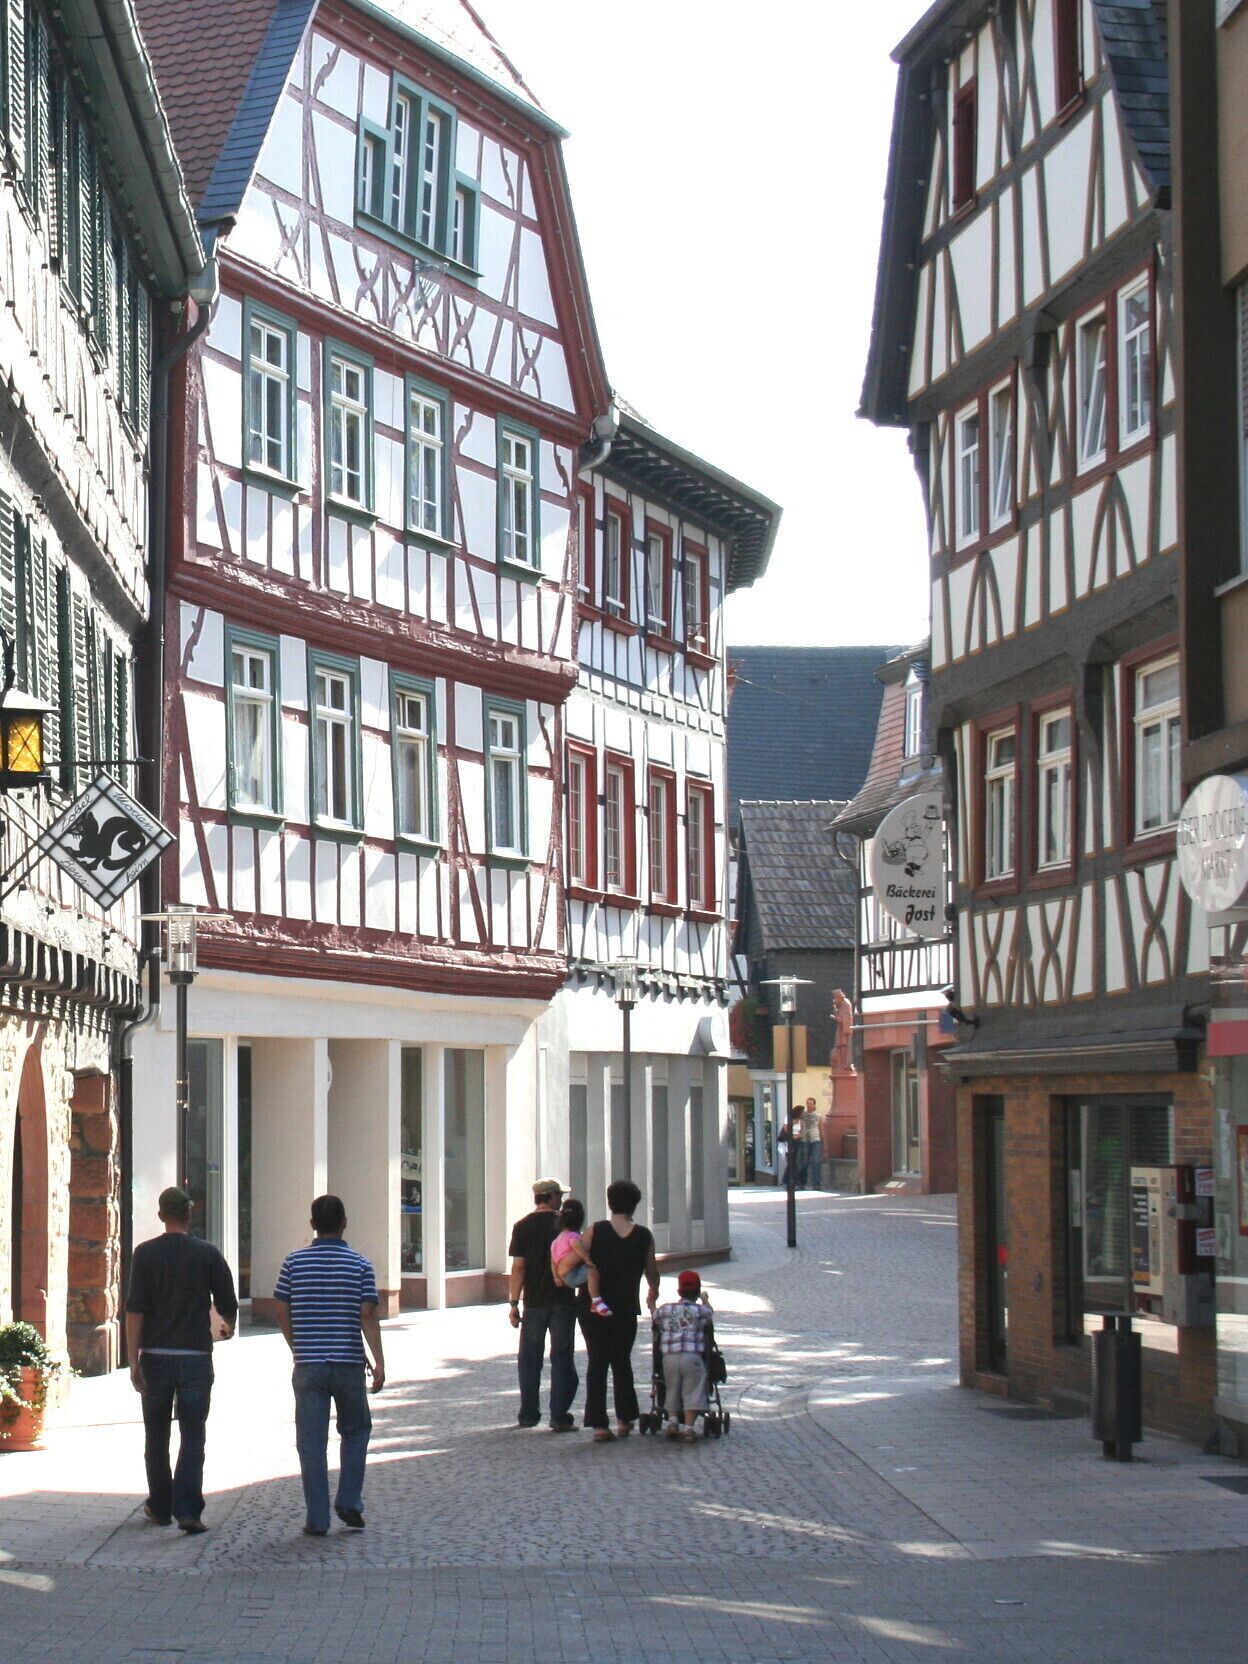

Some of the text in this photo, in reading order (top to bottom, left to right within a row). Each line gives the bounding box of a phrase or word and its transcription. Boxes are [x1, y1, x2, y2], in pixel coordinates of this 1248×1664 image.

[61, 793, 91, 832] Zobel
[113, 791, 154, 832] Moden
[886, 884, 936, 898] Bäckerei
[905, 904, 936, 925] Jost
